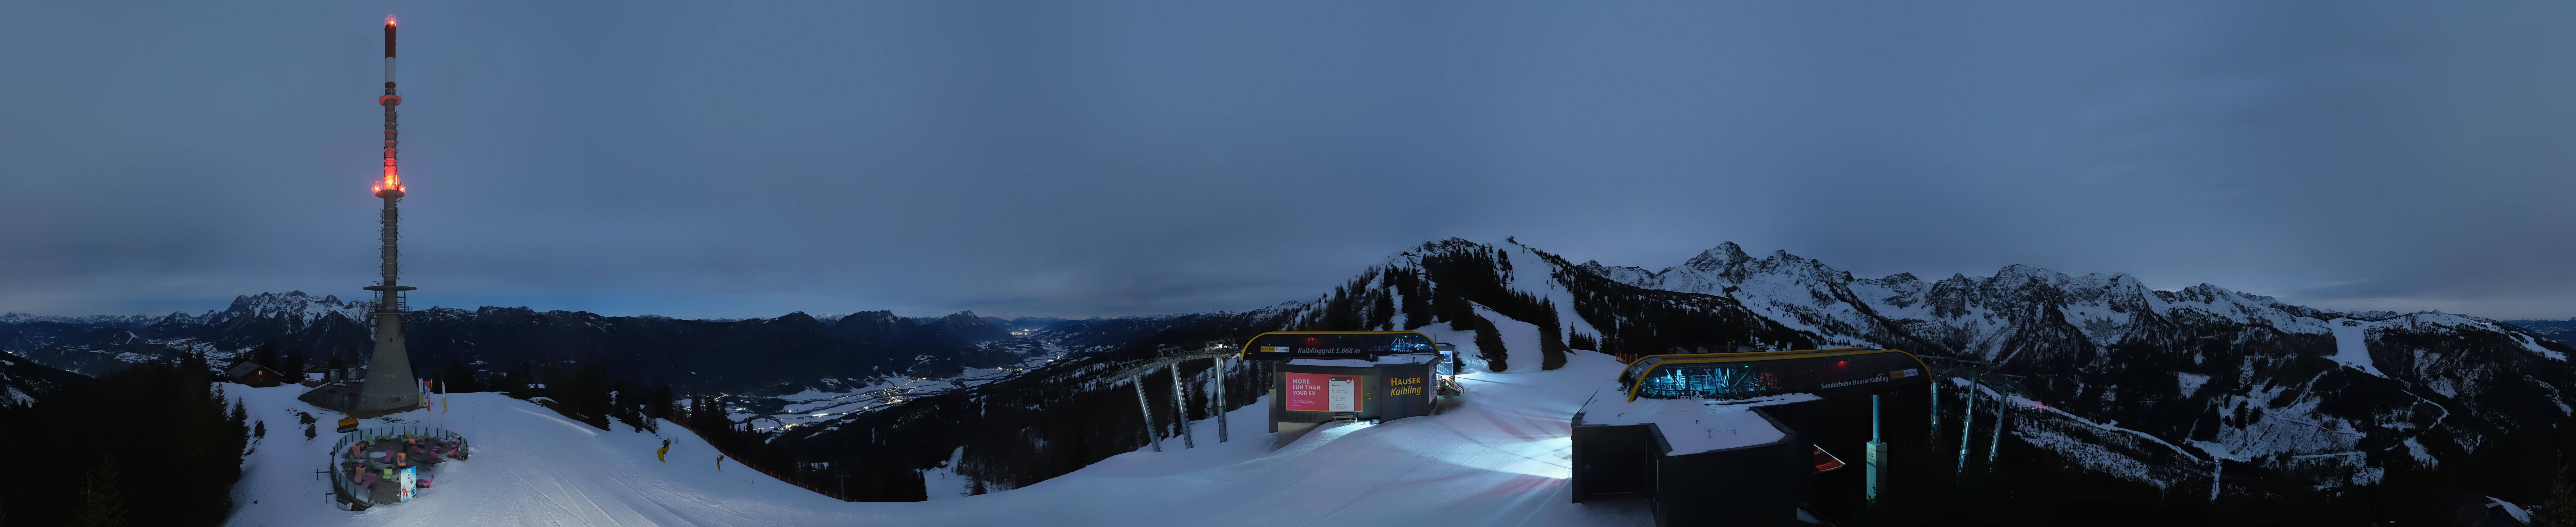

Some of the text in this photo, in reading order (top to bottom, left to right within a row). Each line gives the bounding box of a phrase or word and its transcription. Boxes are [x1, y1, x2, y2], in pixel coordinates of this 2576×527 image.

[1391, 377, 1421, 386] HAUSER
[1821, 380, 1851, 389] Senderbahn
[1391, 386, 1421, 396] Kaibling
